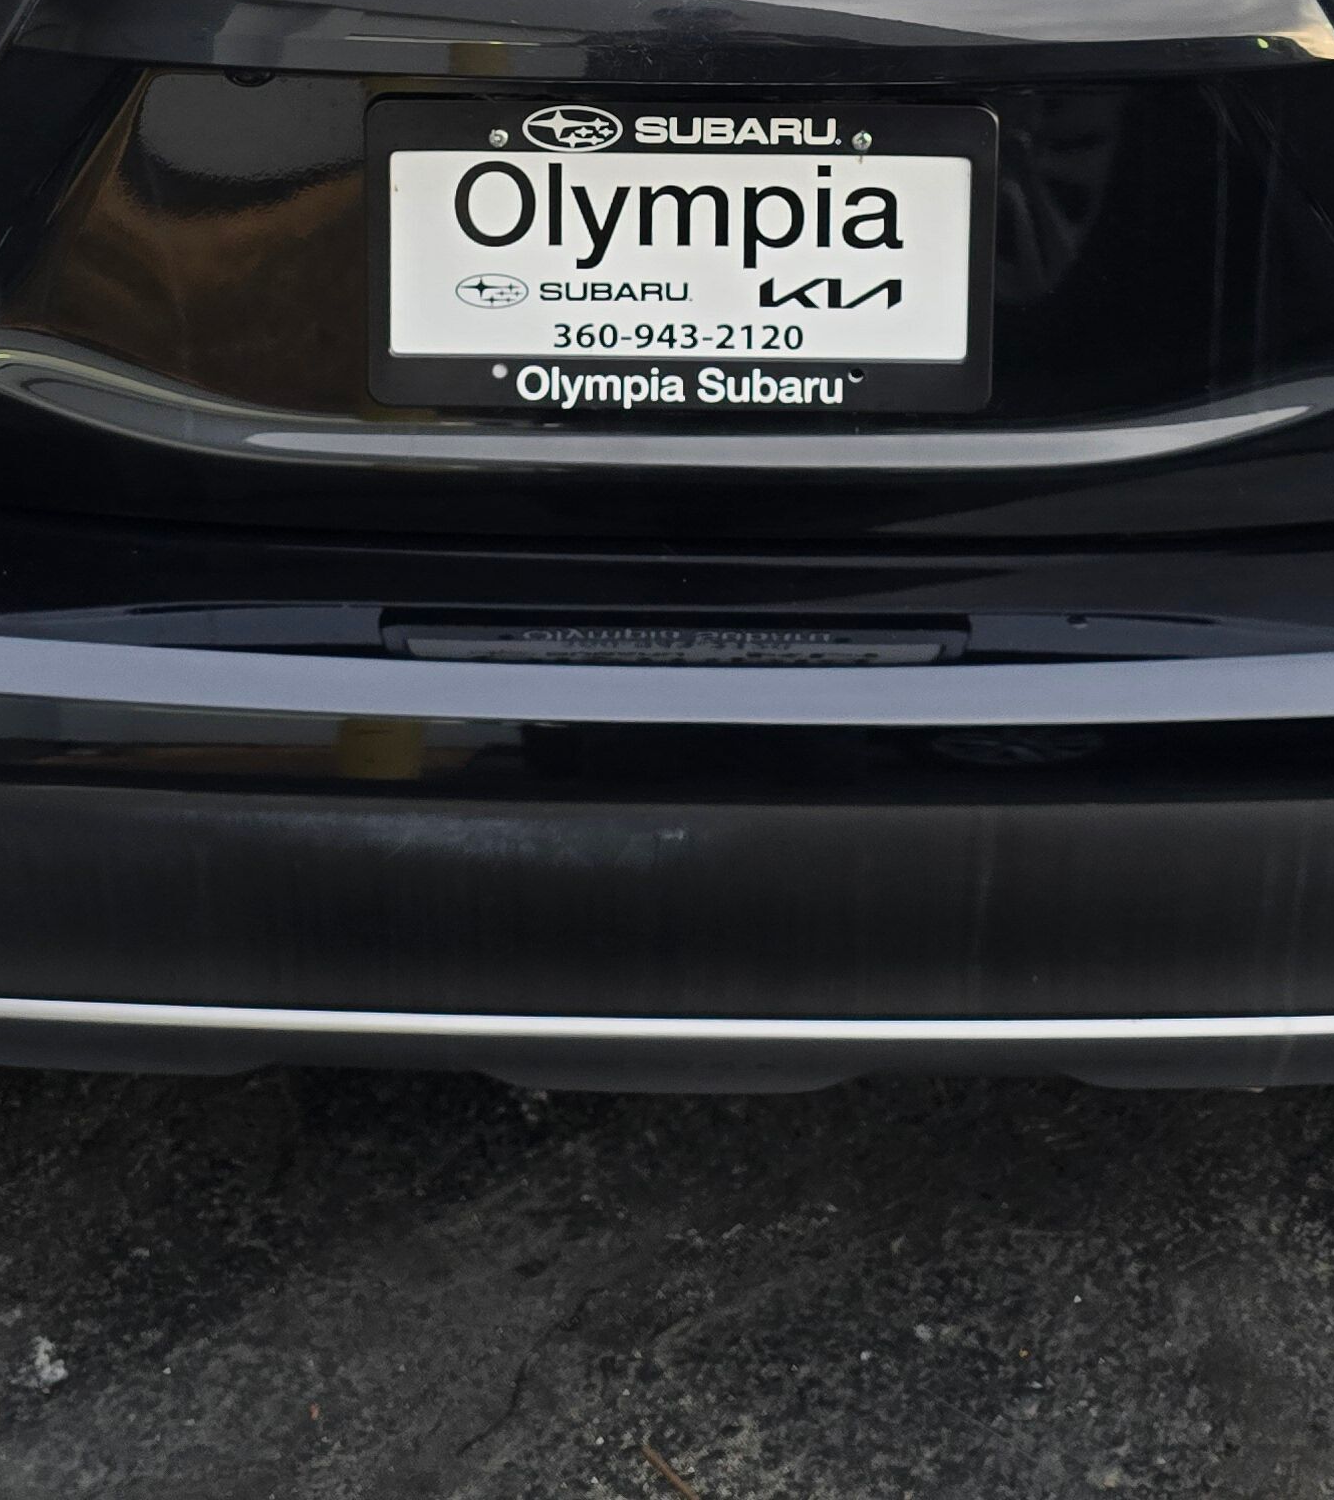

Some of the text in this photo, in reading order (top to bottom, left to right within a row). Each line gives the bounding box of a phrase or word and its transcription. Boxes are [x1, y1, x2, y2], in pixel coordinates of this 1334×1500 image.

[634, 116, 836, 146] SUBARU
[454, 160, 904, 270] Olympia
[539, 282, 688, 303] SUBARU
[553, 323, 804, 351] 360-943-2120
[516, 365, 843, 409] Olympia Subaru
